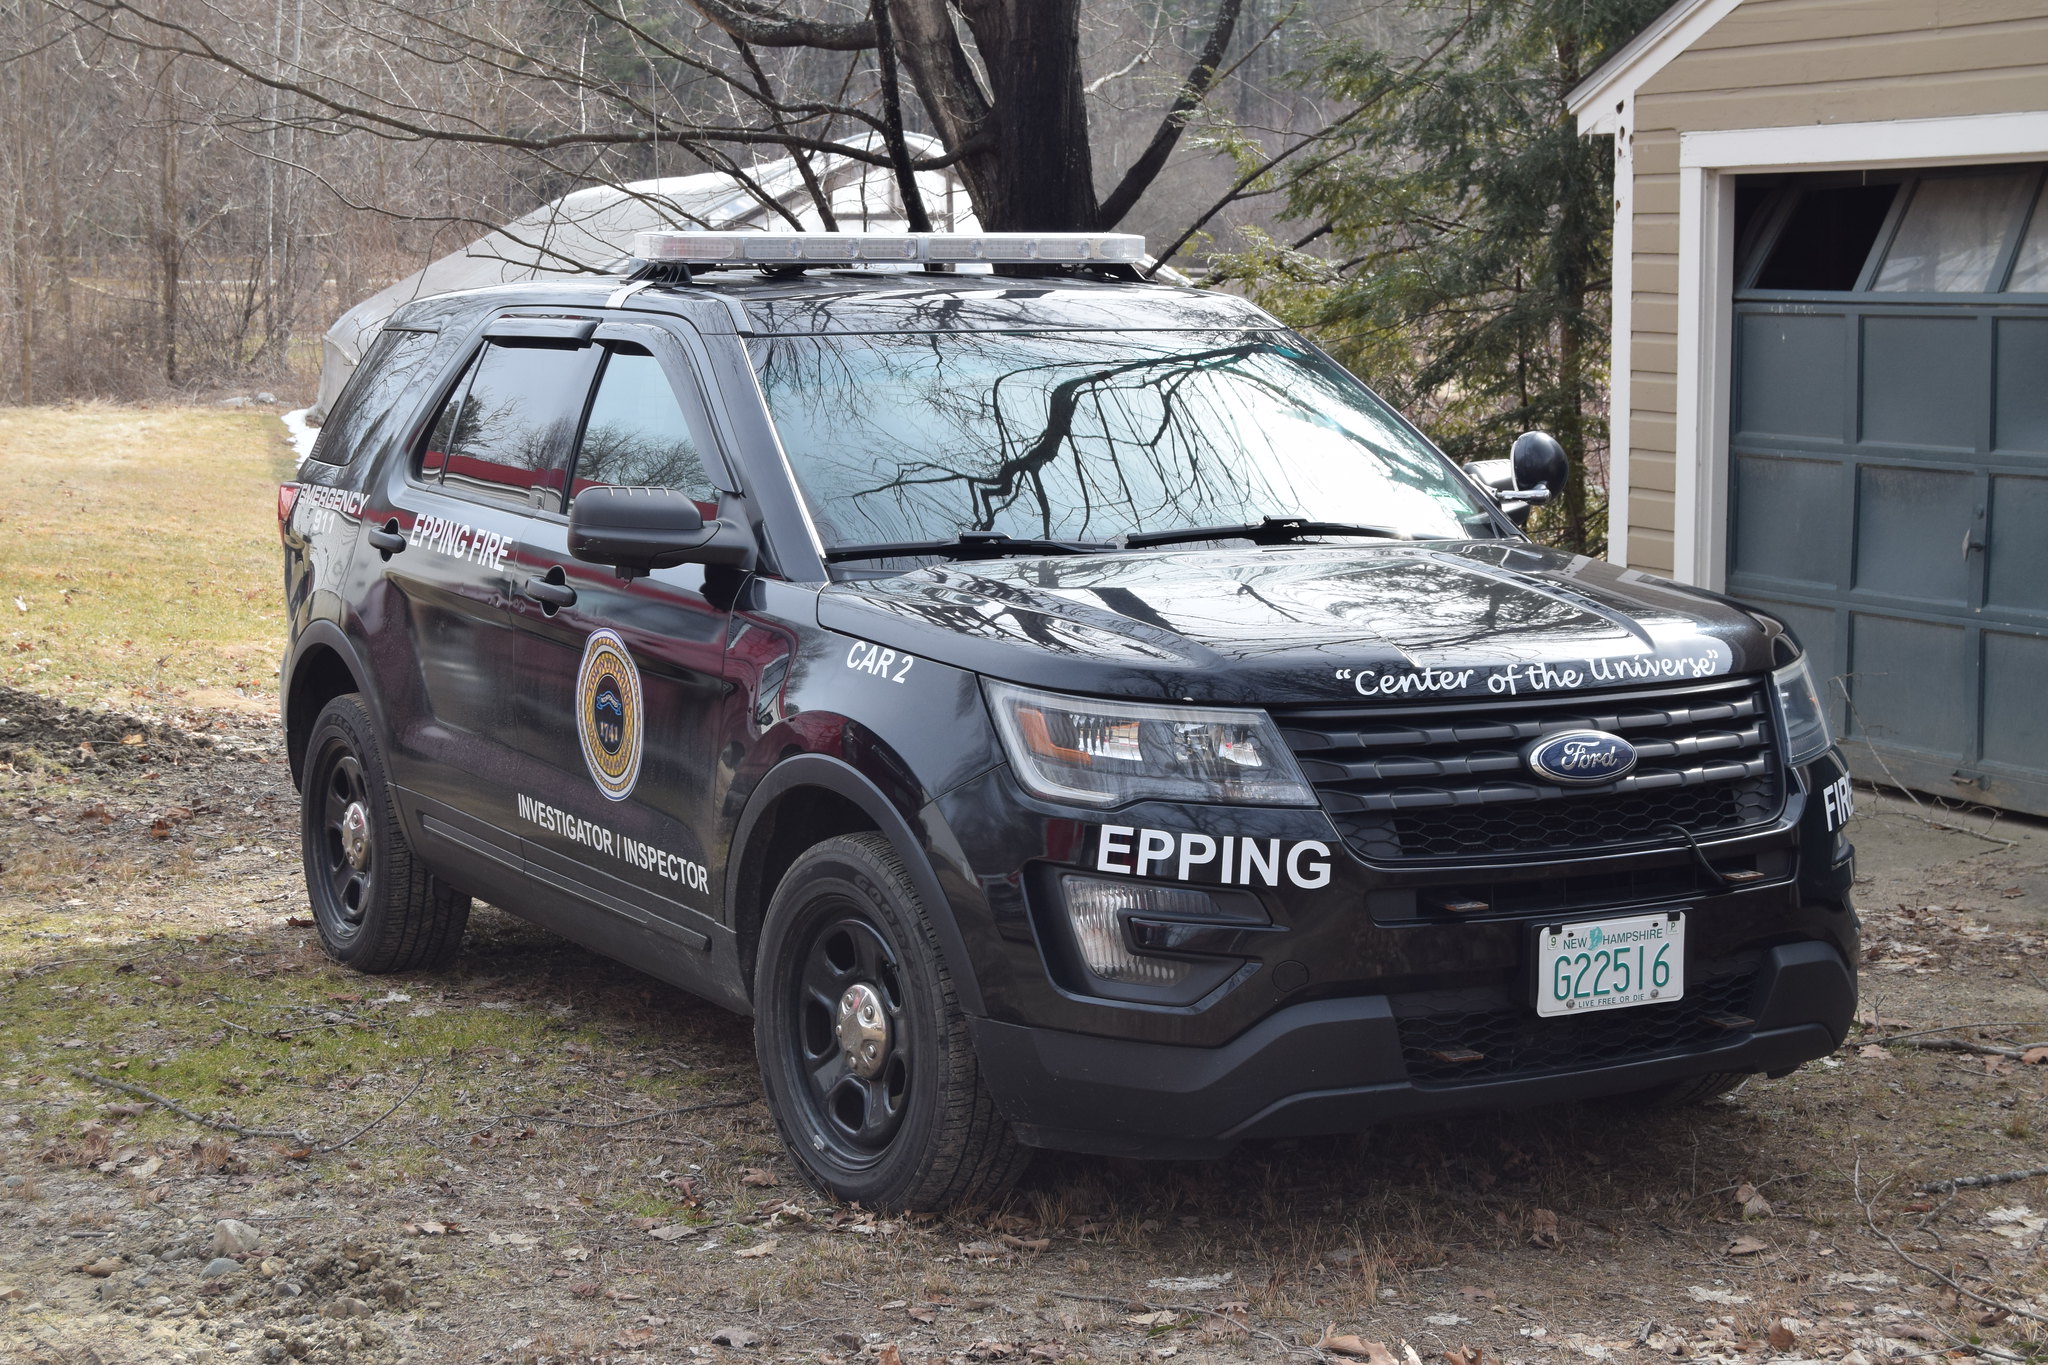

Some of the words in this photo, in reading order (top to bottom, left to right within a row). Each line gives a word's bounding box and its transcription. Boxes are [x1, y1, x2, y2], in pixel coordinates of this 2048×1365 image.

[298, 483, 371, 515] EMERGENCY
[312, 509, 336, 535] 911
[409, 513, 470, 559] EPPING
[468, 528, 513, 572] FIRE
[846, 640, 896, 679] CAR
[892, 655, 914, 684] 2
[1487, 663, 1522, 695] of
[1526, 662, 1584, 691] the
[1560, 741, 1618, 771] Ford
[1823, 770, 1854, 832] FIRE
[517, 792, 615, 856] INVESTIGATOR
[623, 836, 710, 895] INSPECTOR
[1097, 824, 1332, 890] EPPING
[1563, 937, 1588, 950] NEW
[1602, 928, 1663, 945] HAMPSHIRE
[1553, 942, 1670, 1001] G22516
[1578, 999, 1594, 1008] LIVE
[1598, 997, 1616, 1005] FREE
[1619, 995, 1630, 1003] OR
[1633, 993, 1645, 1001] DIE
